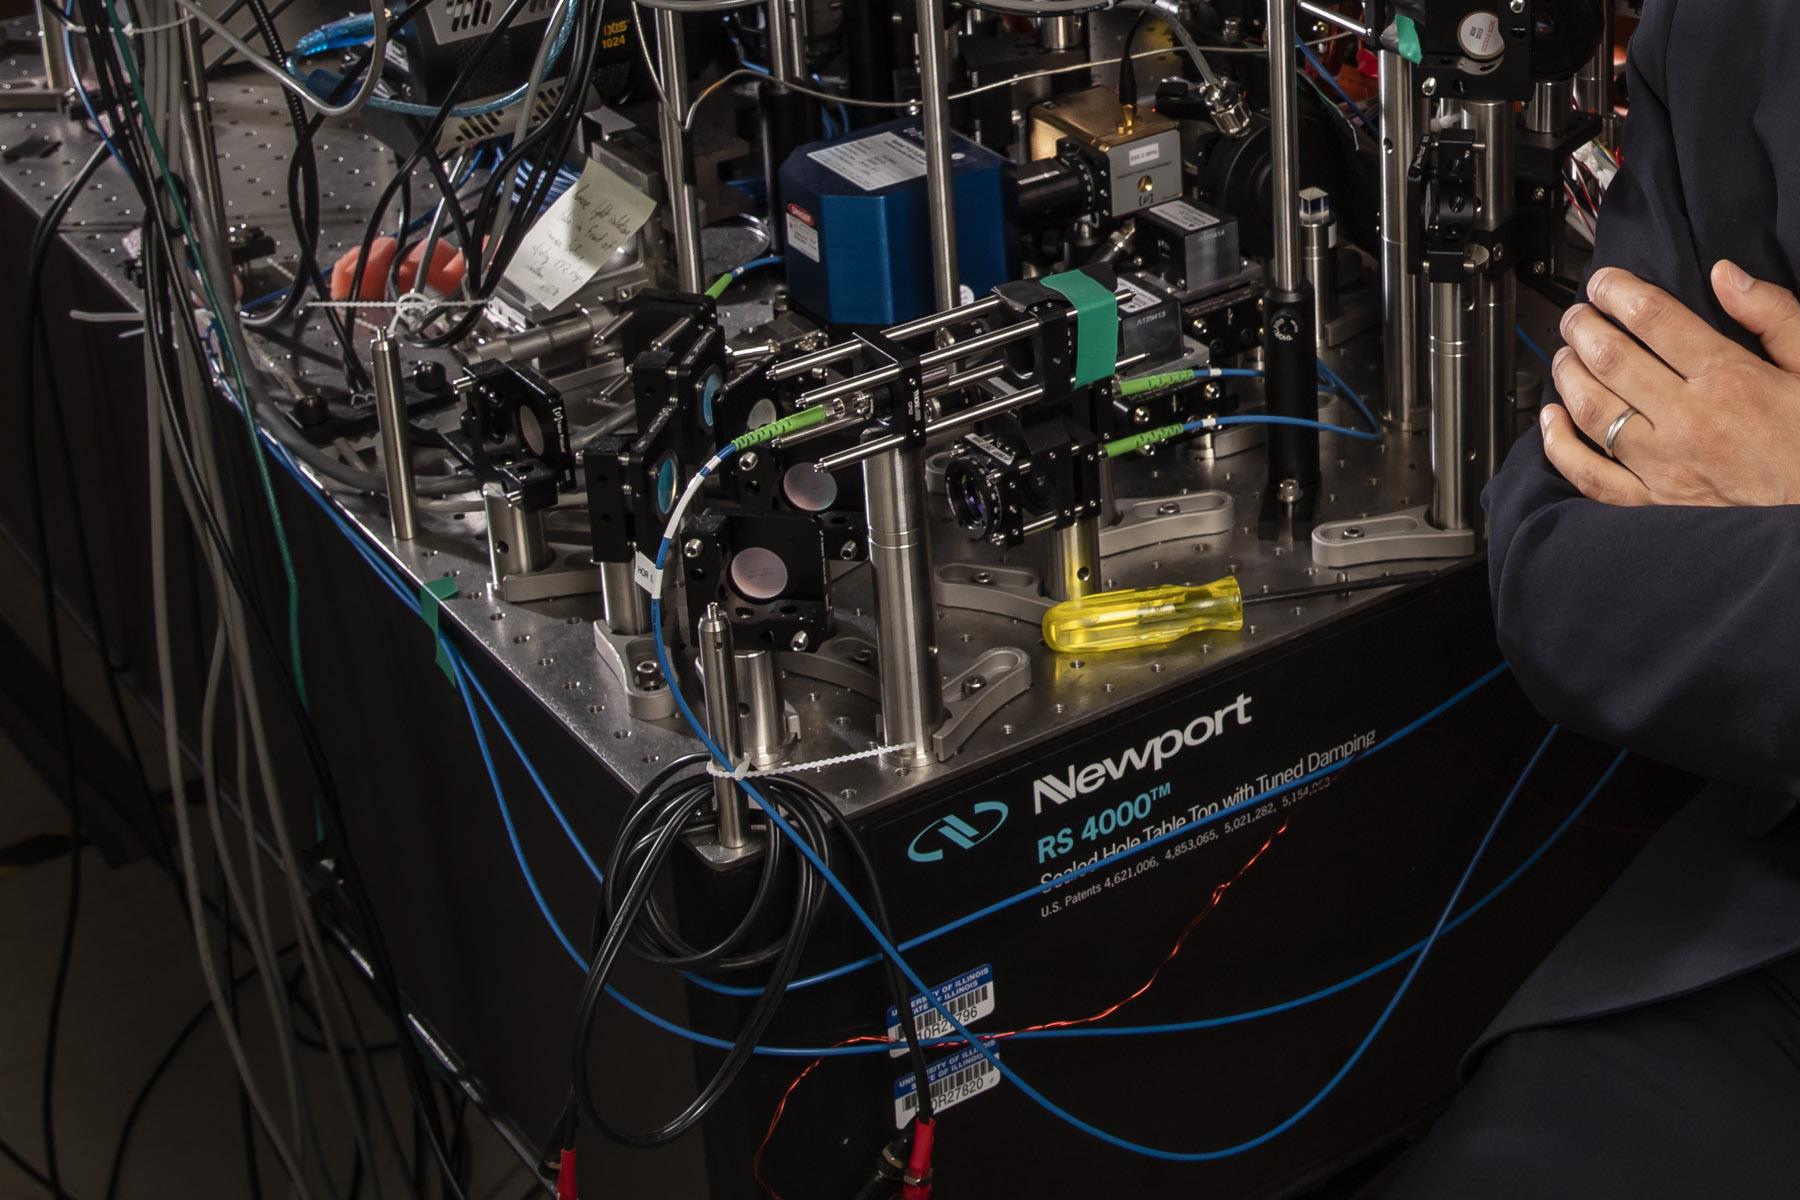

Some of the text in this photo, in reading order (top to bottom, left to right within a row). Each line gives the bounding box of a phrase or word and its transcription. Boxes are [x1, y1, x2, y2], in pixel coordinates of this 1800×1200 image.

[601, 35, 625, 49] 1024
[1033, 693, 1252, 815] Newport
[1103, 835, 1141, 860] Hole
[1142, 815, 1187, 842] Table
[1222, 782, 1255, 808] with
[1256, 757, 1304, 793] Tuned
[1308, 729, 1376, 773] Damping
[1038, 827, 1075, 864] RS
[1040, 901, 1062, 918] U.S.
[1065, 882, 1102, 907] Patents
[1104, 856, 1160, 888] 4,621,006,
[1165, 829, 1219, 860] 4,853,065,
[1225, 803, 1277, 834] 5,021,282,
[942, 983, 953, 993] OF
[955, 966, 989, 988] ILLINOIS
[944, 981, 978, 1000] ILLINOIS
[949, 1054, 960, 1064] OF
[938, 1068, 948, 1078] OF
